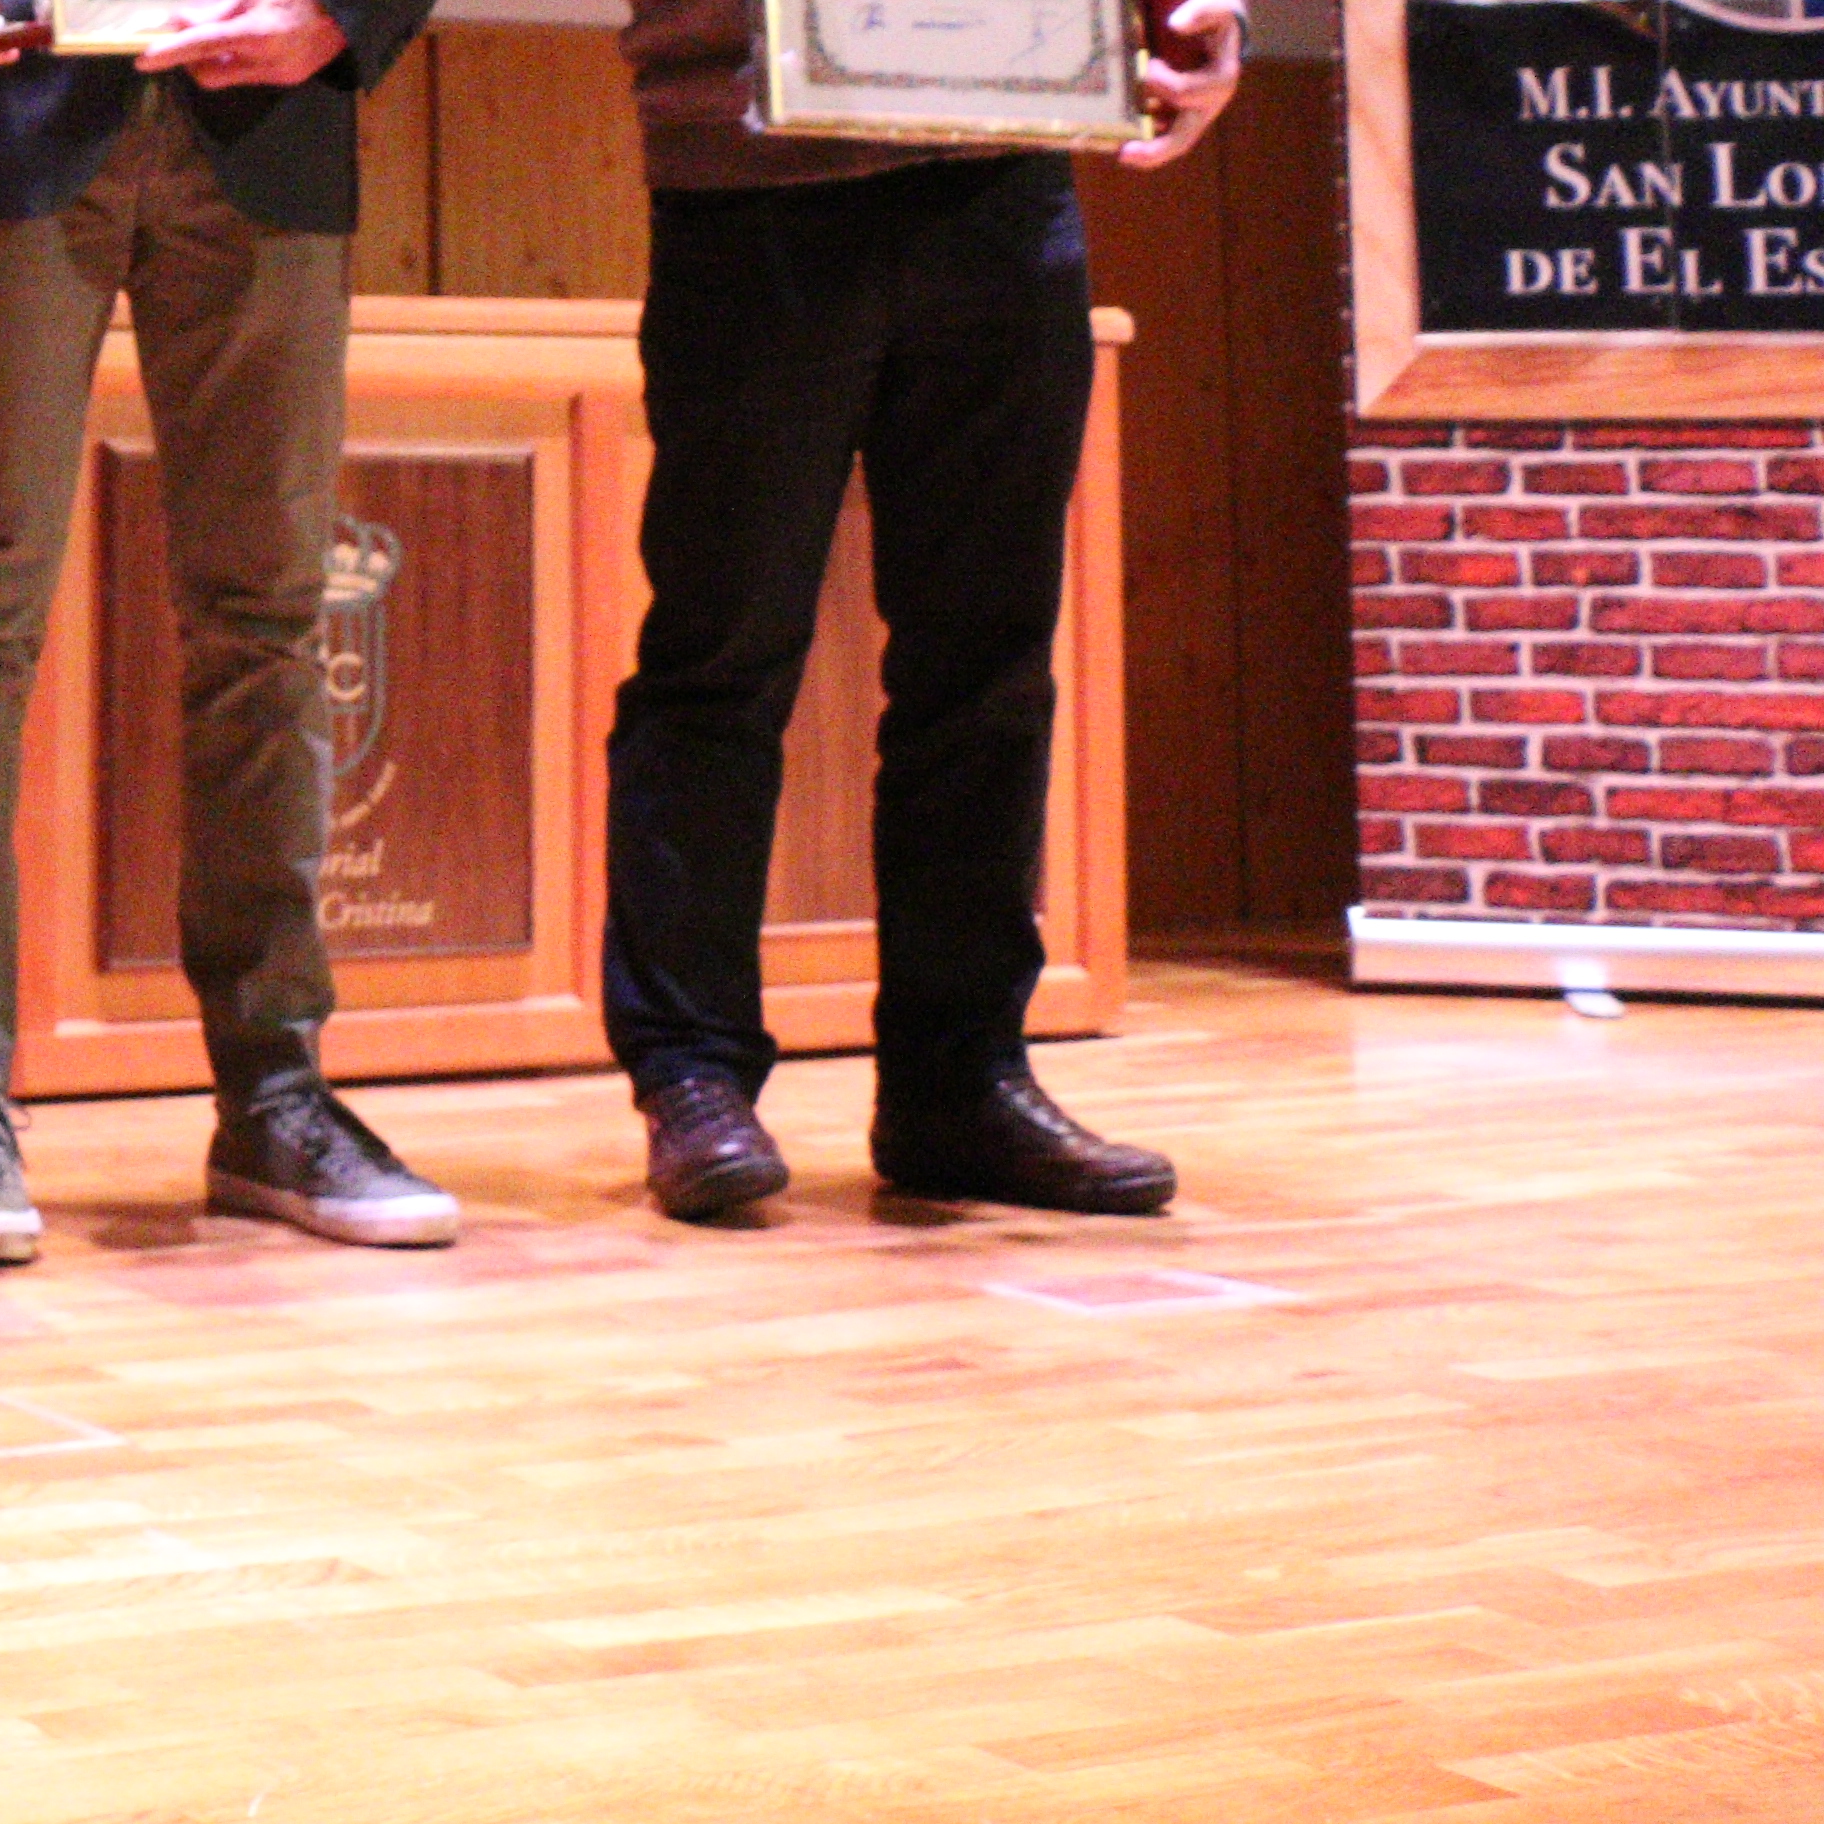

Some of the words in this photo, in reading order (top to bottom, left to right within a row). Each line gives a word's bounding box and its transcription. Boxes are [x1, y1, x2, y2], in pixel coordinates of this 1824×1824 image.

[1517, 64, 1633, 120] M.I.
[1543, 141, 1684, 209] SAN
[1707, 141, 1824, 209] LO
[1505, 247, 1598, 296] DE
[1621, 227, 1724, 298] EL
